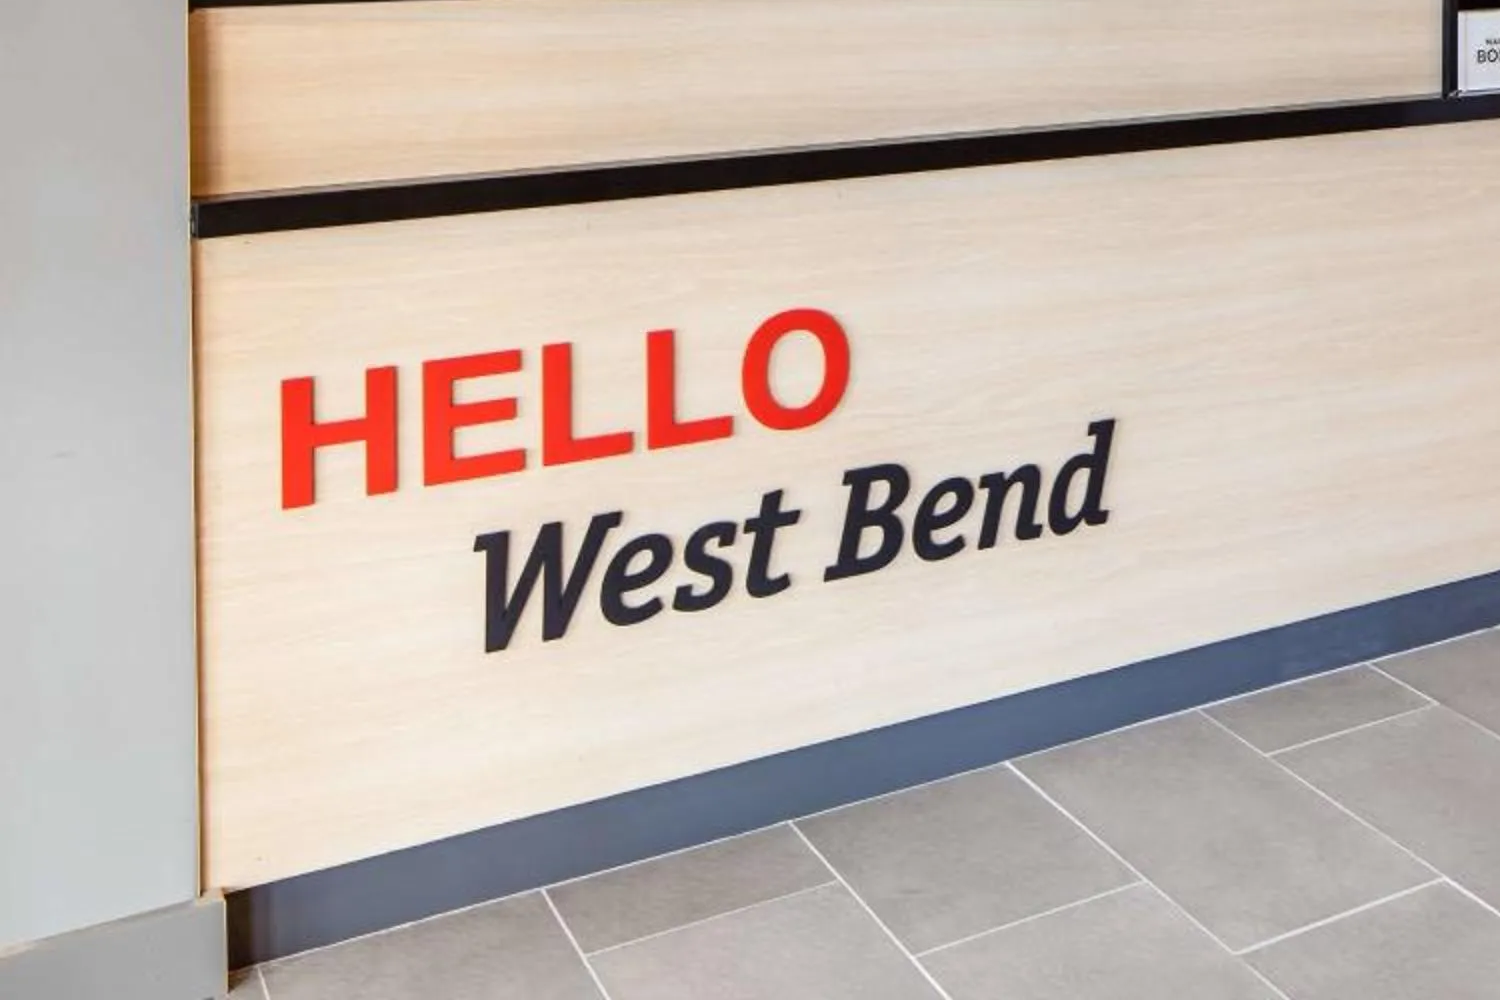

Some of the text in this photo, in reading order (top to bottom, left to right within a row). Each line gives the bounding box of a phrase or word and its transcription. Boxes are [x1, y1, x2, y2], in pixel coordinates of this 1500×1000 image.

[281, 308, 850, 510] HELLO
[473, 418, 1117, 654] West Bend
